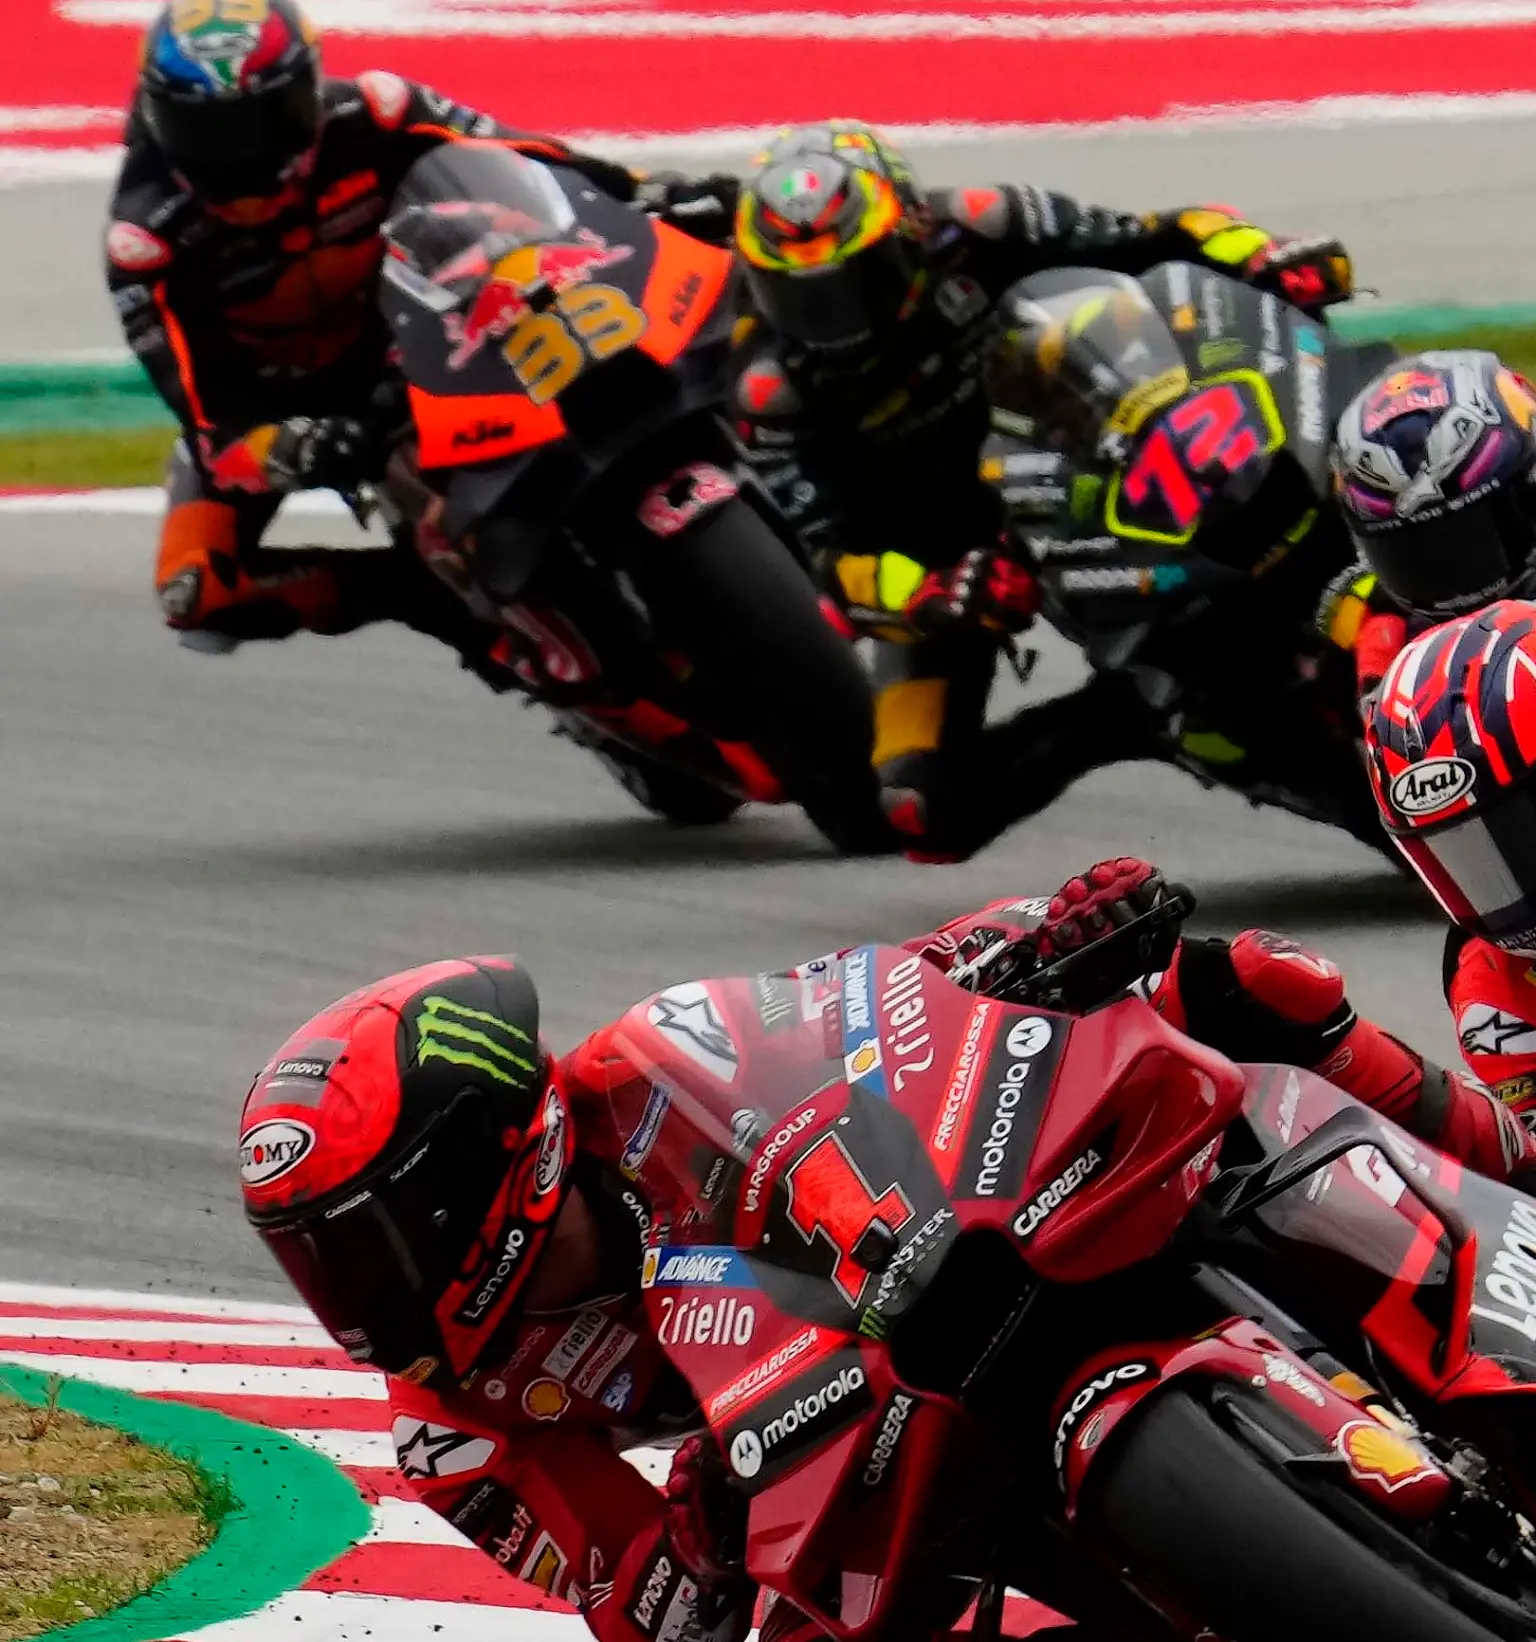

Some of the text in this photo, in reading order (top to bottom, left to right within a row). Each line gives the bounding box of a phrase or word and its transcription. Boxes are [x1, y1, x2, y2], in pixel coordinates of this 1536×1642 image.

[503, 283, 647, 406] 33
[1124, 386, 1258, 527] 72
[1398, 762, 1461, 805] Arai
[844, 951, 871, 1033] ADVANCE
[883, 956, 932, 1056] riello
[276, 1061, 324, 1077] Lenovo
[932, 1003, 991, 1152] FRECCIAROSSA
[240, 1138, 301, 1168] UOMY
[742, 1106, 818, 1213] VARGROUP
[974, 1061, 1031, 1197] motorola
[785, 1130, 917, 1310] 1
[1011, 1149, 1102, 1237] CARRERA
[463, 1229, 525, 1319] Lenovo
[657, 1255, 733, 1283] ADVANCE
[676, 1297, 754, 1346] riello
[710, 1327, 818, 1415] FRECCIAROSSA
[761, 1366, 867, 1451] motorola
[863, 1394, 915, 1488] CARRERA
